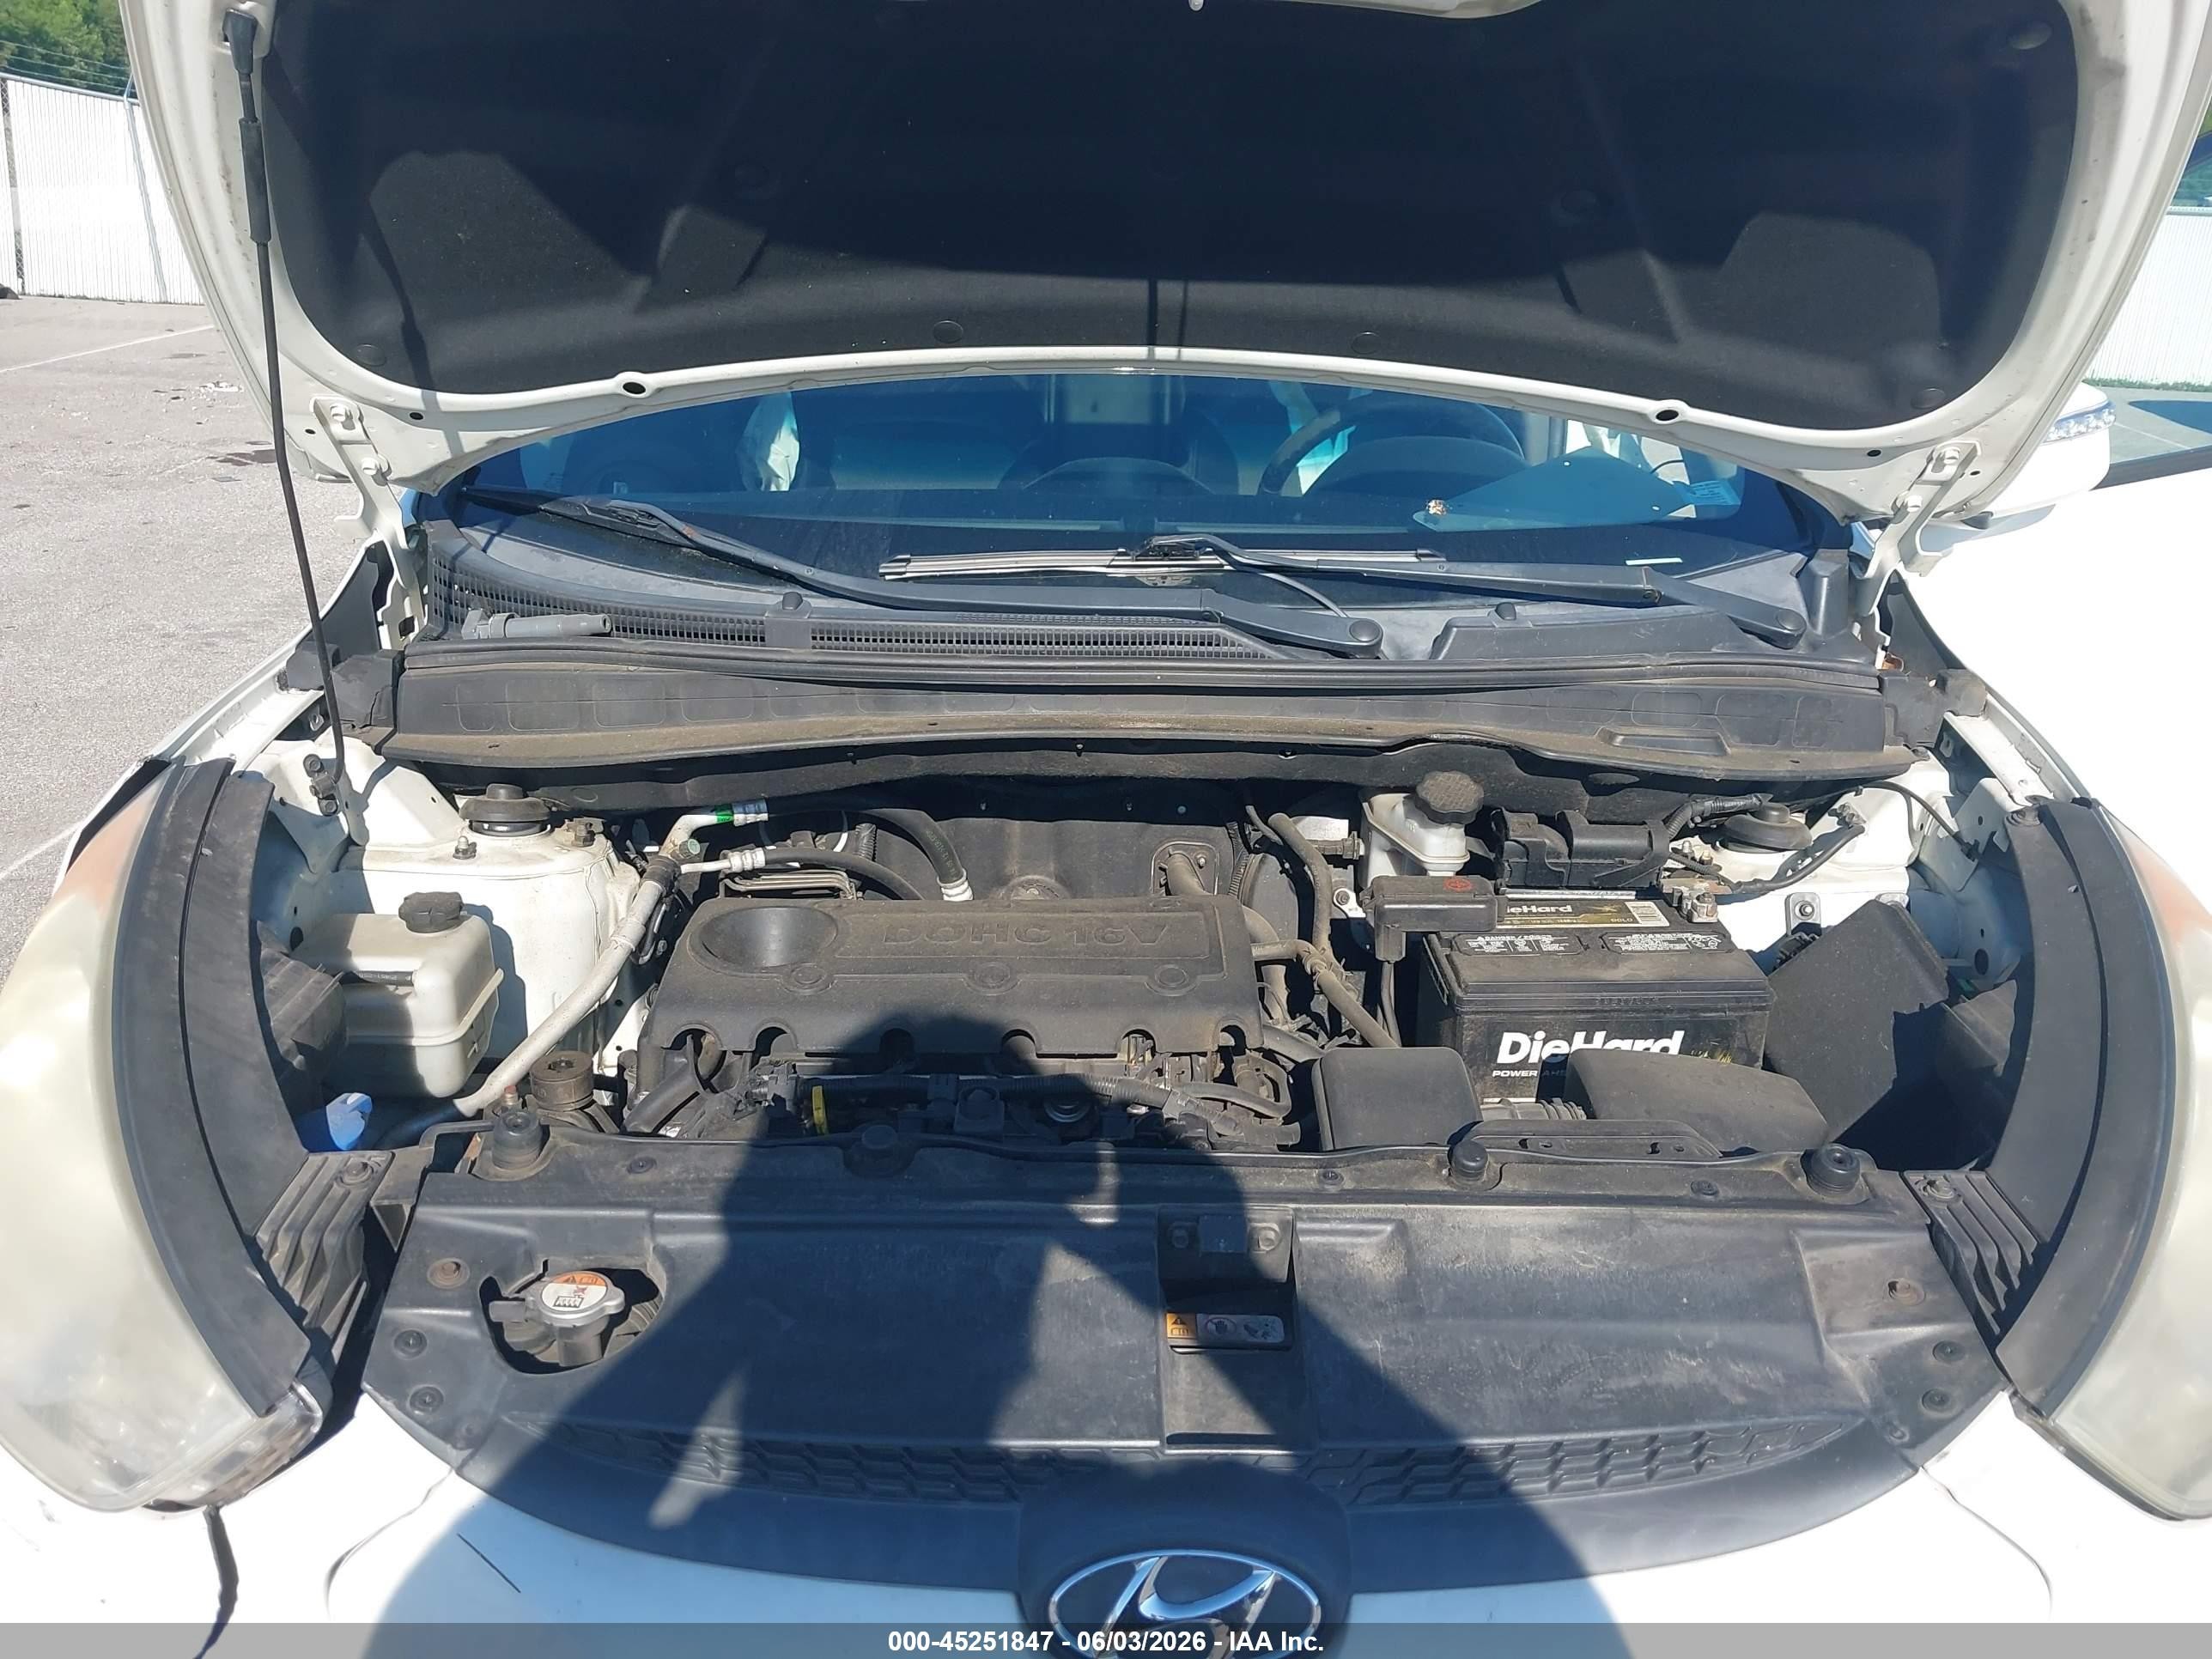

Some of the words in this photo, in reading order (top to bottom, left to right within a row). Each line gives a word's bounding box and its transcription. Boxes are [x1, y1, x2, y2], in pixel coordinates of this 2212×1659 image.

[1507, 905, 1573, 914] ieHard
[883, 922, 1052, 945] DOHC
[1065, 921, 1168, 945] 16V
